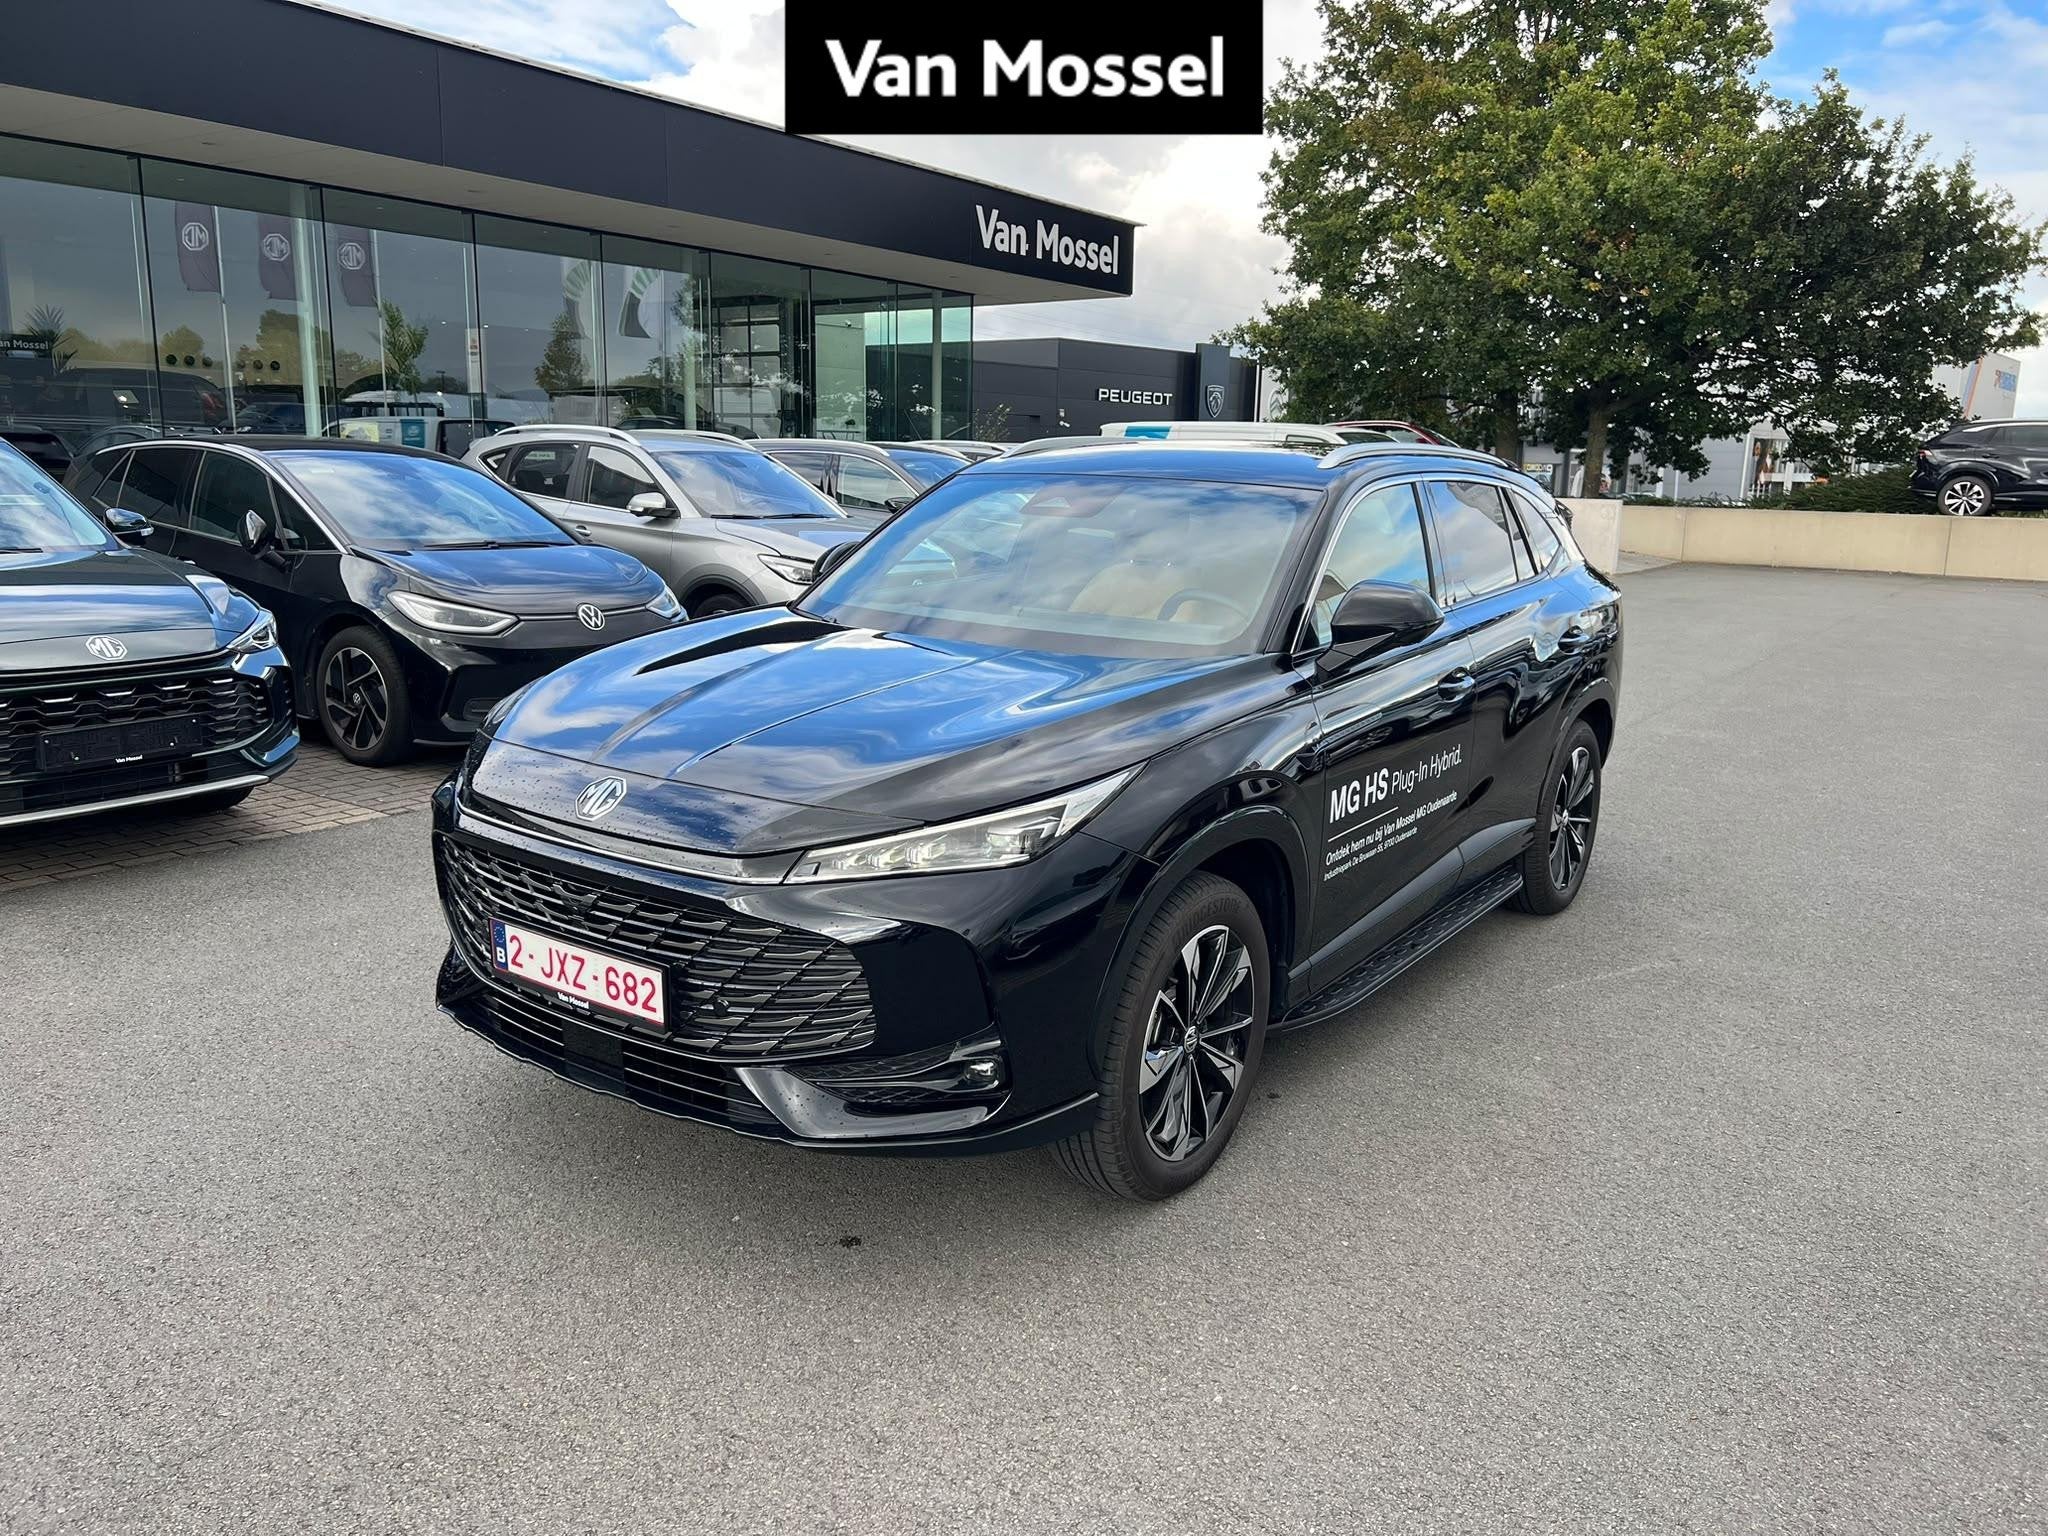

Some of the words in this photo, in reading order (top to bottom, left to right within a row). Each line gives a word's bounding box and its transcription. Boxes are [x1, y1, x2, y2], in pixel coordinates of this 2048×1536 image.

[975, 204, 1028, 256] Van
[1036, 219, 1119, 275] Mossel
[0, 340, 10, 348] an
[13, 339, 49, 350] Mossel
[1098, 388, 1173, 406] PEUGEOT
[579, 604, 605, 630] VW
[88, 636, 126, 660] MG
[1329, 780, 1360, 824] MG
[1364, 768, 1389, 807] HS
[1391, 760, 1428, 795] Plug-In
[1430, 743, 1462, 778] Hybrid.
[576, 777, 625, 819] MG
[1326, 843, 1351, 866] Ontdek
[1351, 838, 1365, 853] hem
[1365, 833, 1375, 846] nu
[1375, 826, 1384, 842] bij
[1384, 822, 1395, 836] Van
[1396, 809, 1416, 830] Mossel
[1416, 804, 1427, 820] MG
[496, 946, 506, 963] B
